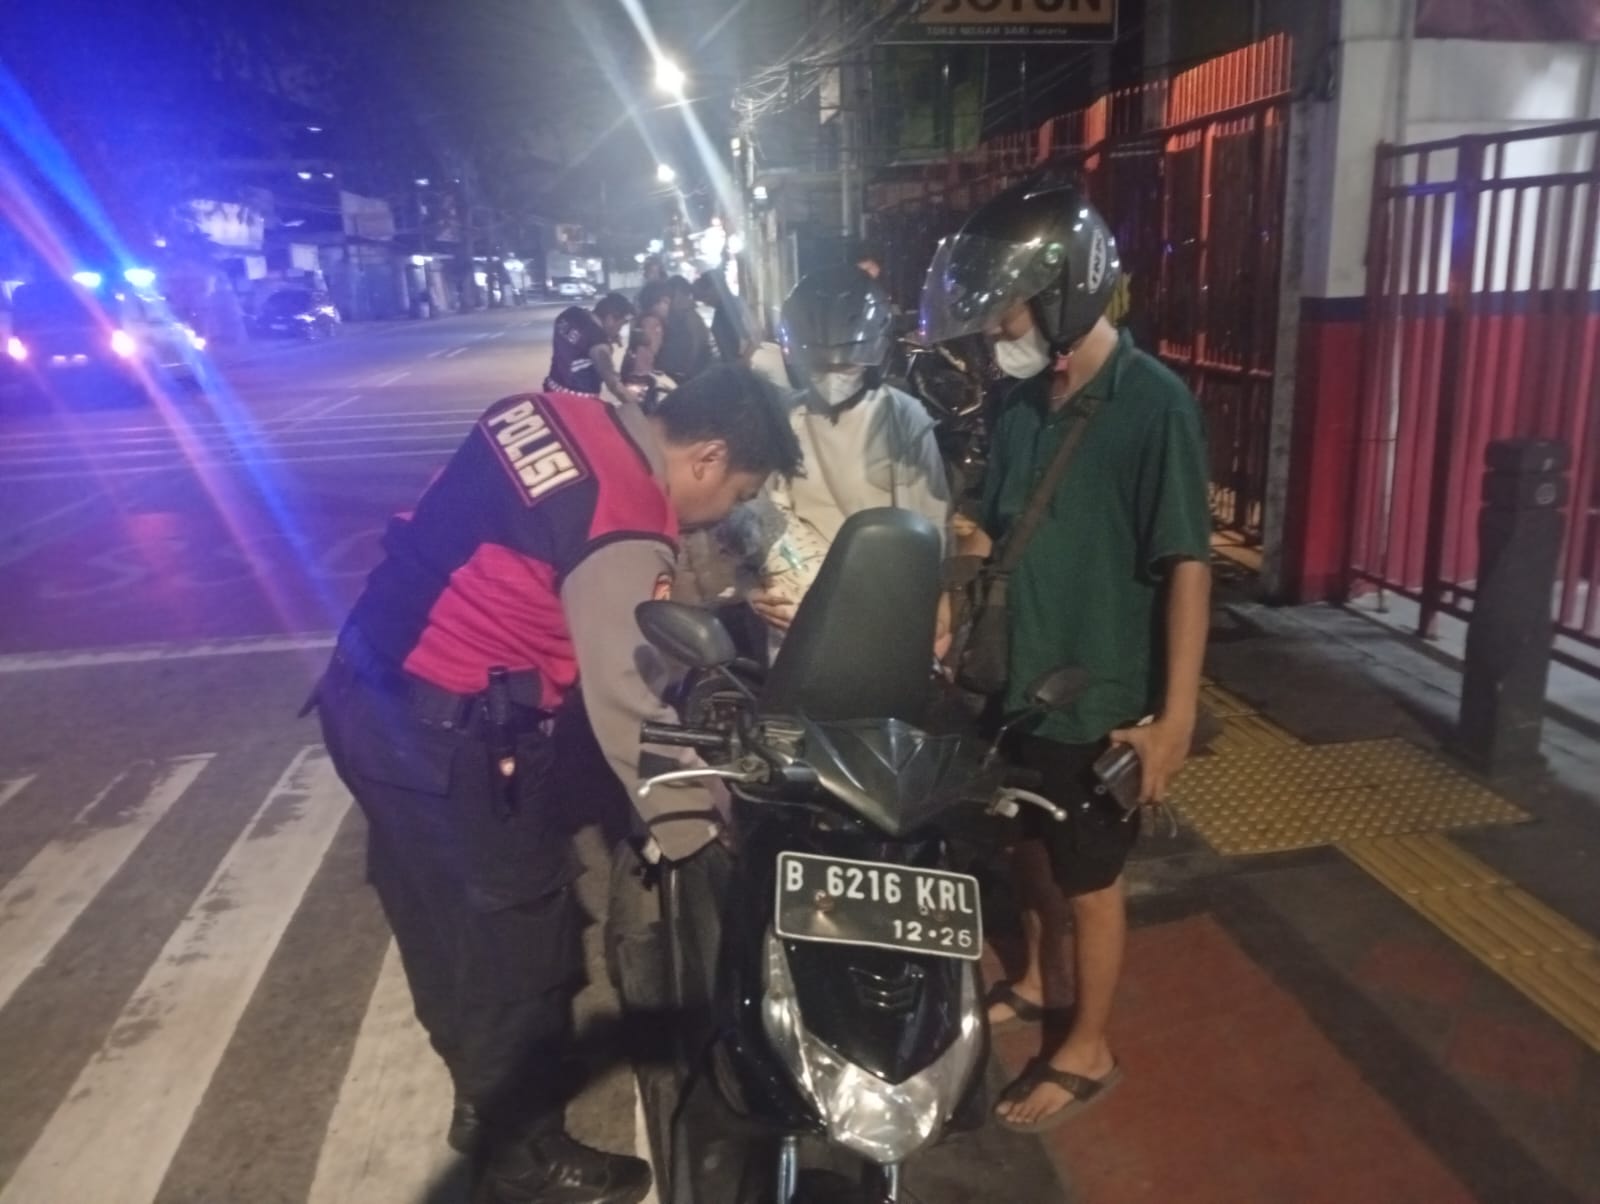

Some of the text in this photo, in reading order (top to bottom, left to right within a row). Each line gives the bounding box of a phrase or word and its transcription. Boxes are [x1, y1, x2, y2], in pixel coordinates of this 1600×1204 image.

[487, 400, 580, 498] POLISI
[786, 860, 973, 914] B 6216 KRL
